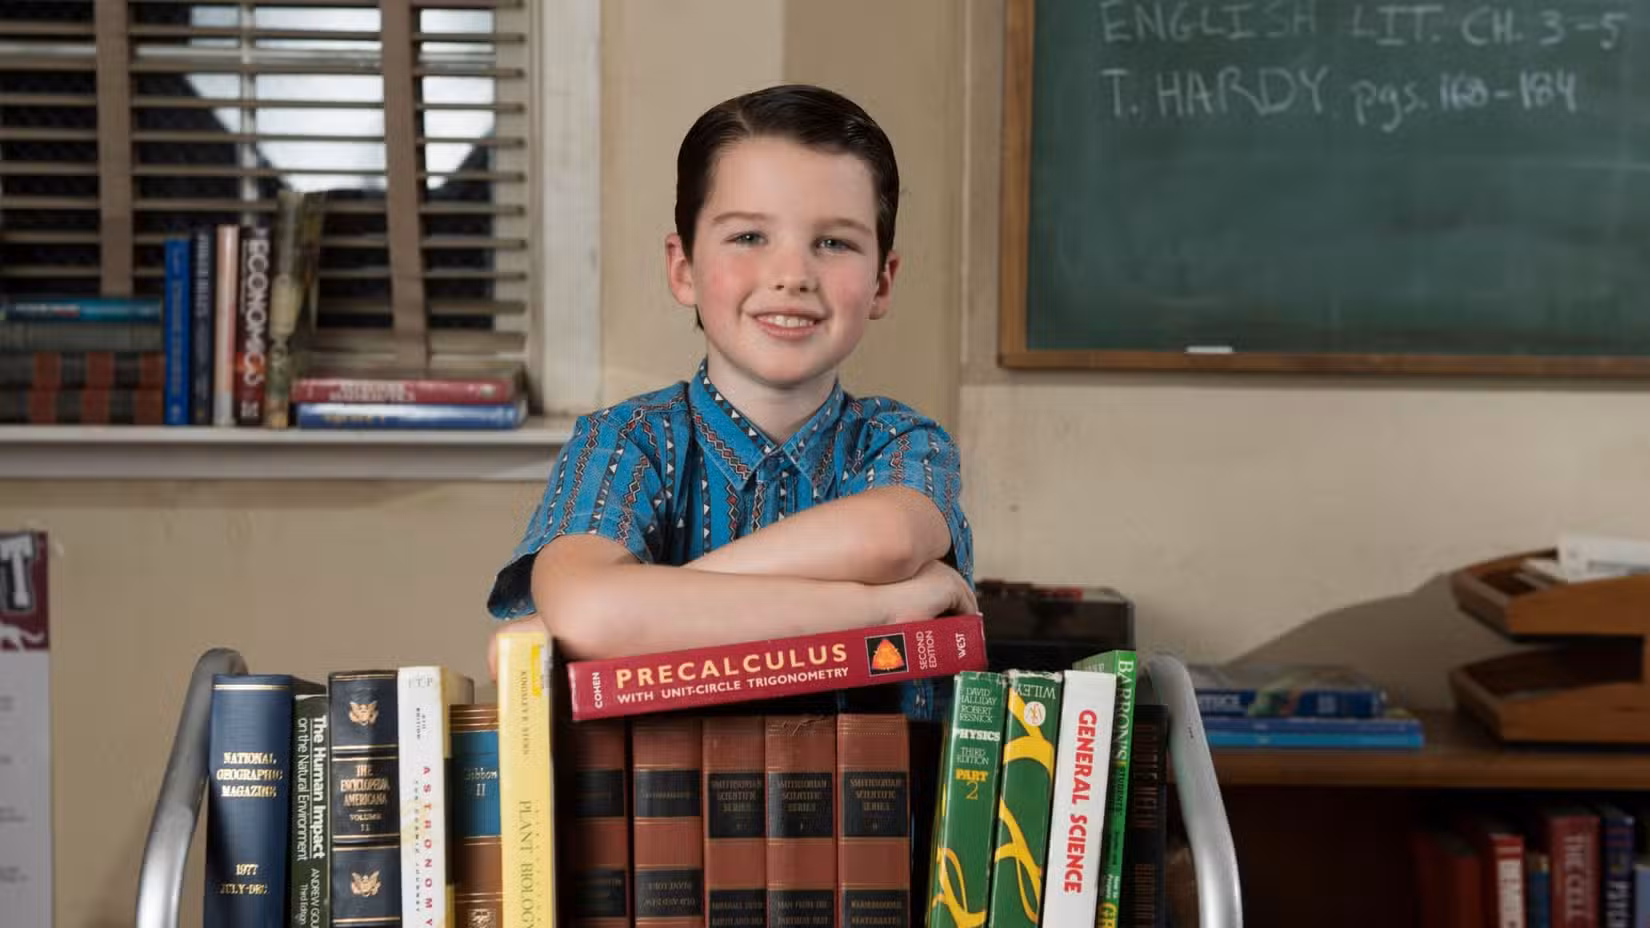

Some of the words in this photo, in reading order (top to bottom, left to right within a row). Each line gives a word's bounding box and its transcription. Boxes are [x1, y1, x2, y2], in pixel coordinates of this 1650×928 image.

[1102, 0, 1317, 44] ENGLISH
[1352, 4, 1443, 46] LIT.
[1461, 6, 1522, 46] CH.
[1538, 11, 1628, 49] 3-5
[1102, 68, 1138, 117] T.
[1158, 64, 1329, 117] HARDY
[1352, 80, 1428, 132] pgs.
[243, 239, 267, 386] ECONOMICS
[916, 631, 928, 670] SECOND
[925, 630, 938, 668] EDITION
[955, 632, 967, 660] WEST
[615, 643, 848, 689] PRECALCULUS
[593, 672, 603, 709] COHEN
[617, 690, 654, 705] WITH
[661, 680, 741, 700] UNIT-CIRCLE
[747, 667, 849, 689] TRIGONOMETRY
[966, 687, 991, 697] DAVID
[1017, 683, 1057, 700] WILEY
[959, 712, 993, 723] RESNICK
[960, 705, 993, 716] ROBERT
[298, 717, 309, 733] on
[313, 715, 327, 743] The
[955, 728, 1001, 742] PHYSICS
[298, 735, 309, 753] the
[960, 747, 986, 757] THIRD
[1071, 708, 1098, 806] GENERAL
[223, 752, 277, 765] NATIONAL
[356, 764, 374, 778] THE
[956, 755, 989, 765] EDITION
[216, 768, 283, 781] GEOGRAPHIC
[297, 755, 309, 793] Natural
[312, 747, 327, 802] Human
[955, 768, 988, 781] PART
[221, 785, 277, 798] MAGAZINE
[343, 792, 388, 806] AMERICANA
[965, 780, 979, 801] 2
[296, 795, 309, 862] Environment
[309, 805, 326, 860] Impact
[518, 800, 533, 853] PLANT
[422, 766, 433, 927] ASTRONOMY
[1063, 812, 1088, 895] SCIENCE
[235, 864, 259, 876] 1977
[300, 883, 308, 902] Third
[311, 867, 320, 907] ANDREW
[300, 902, 308, 926] Edition
